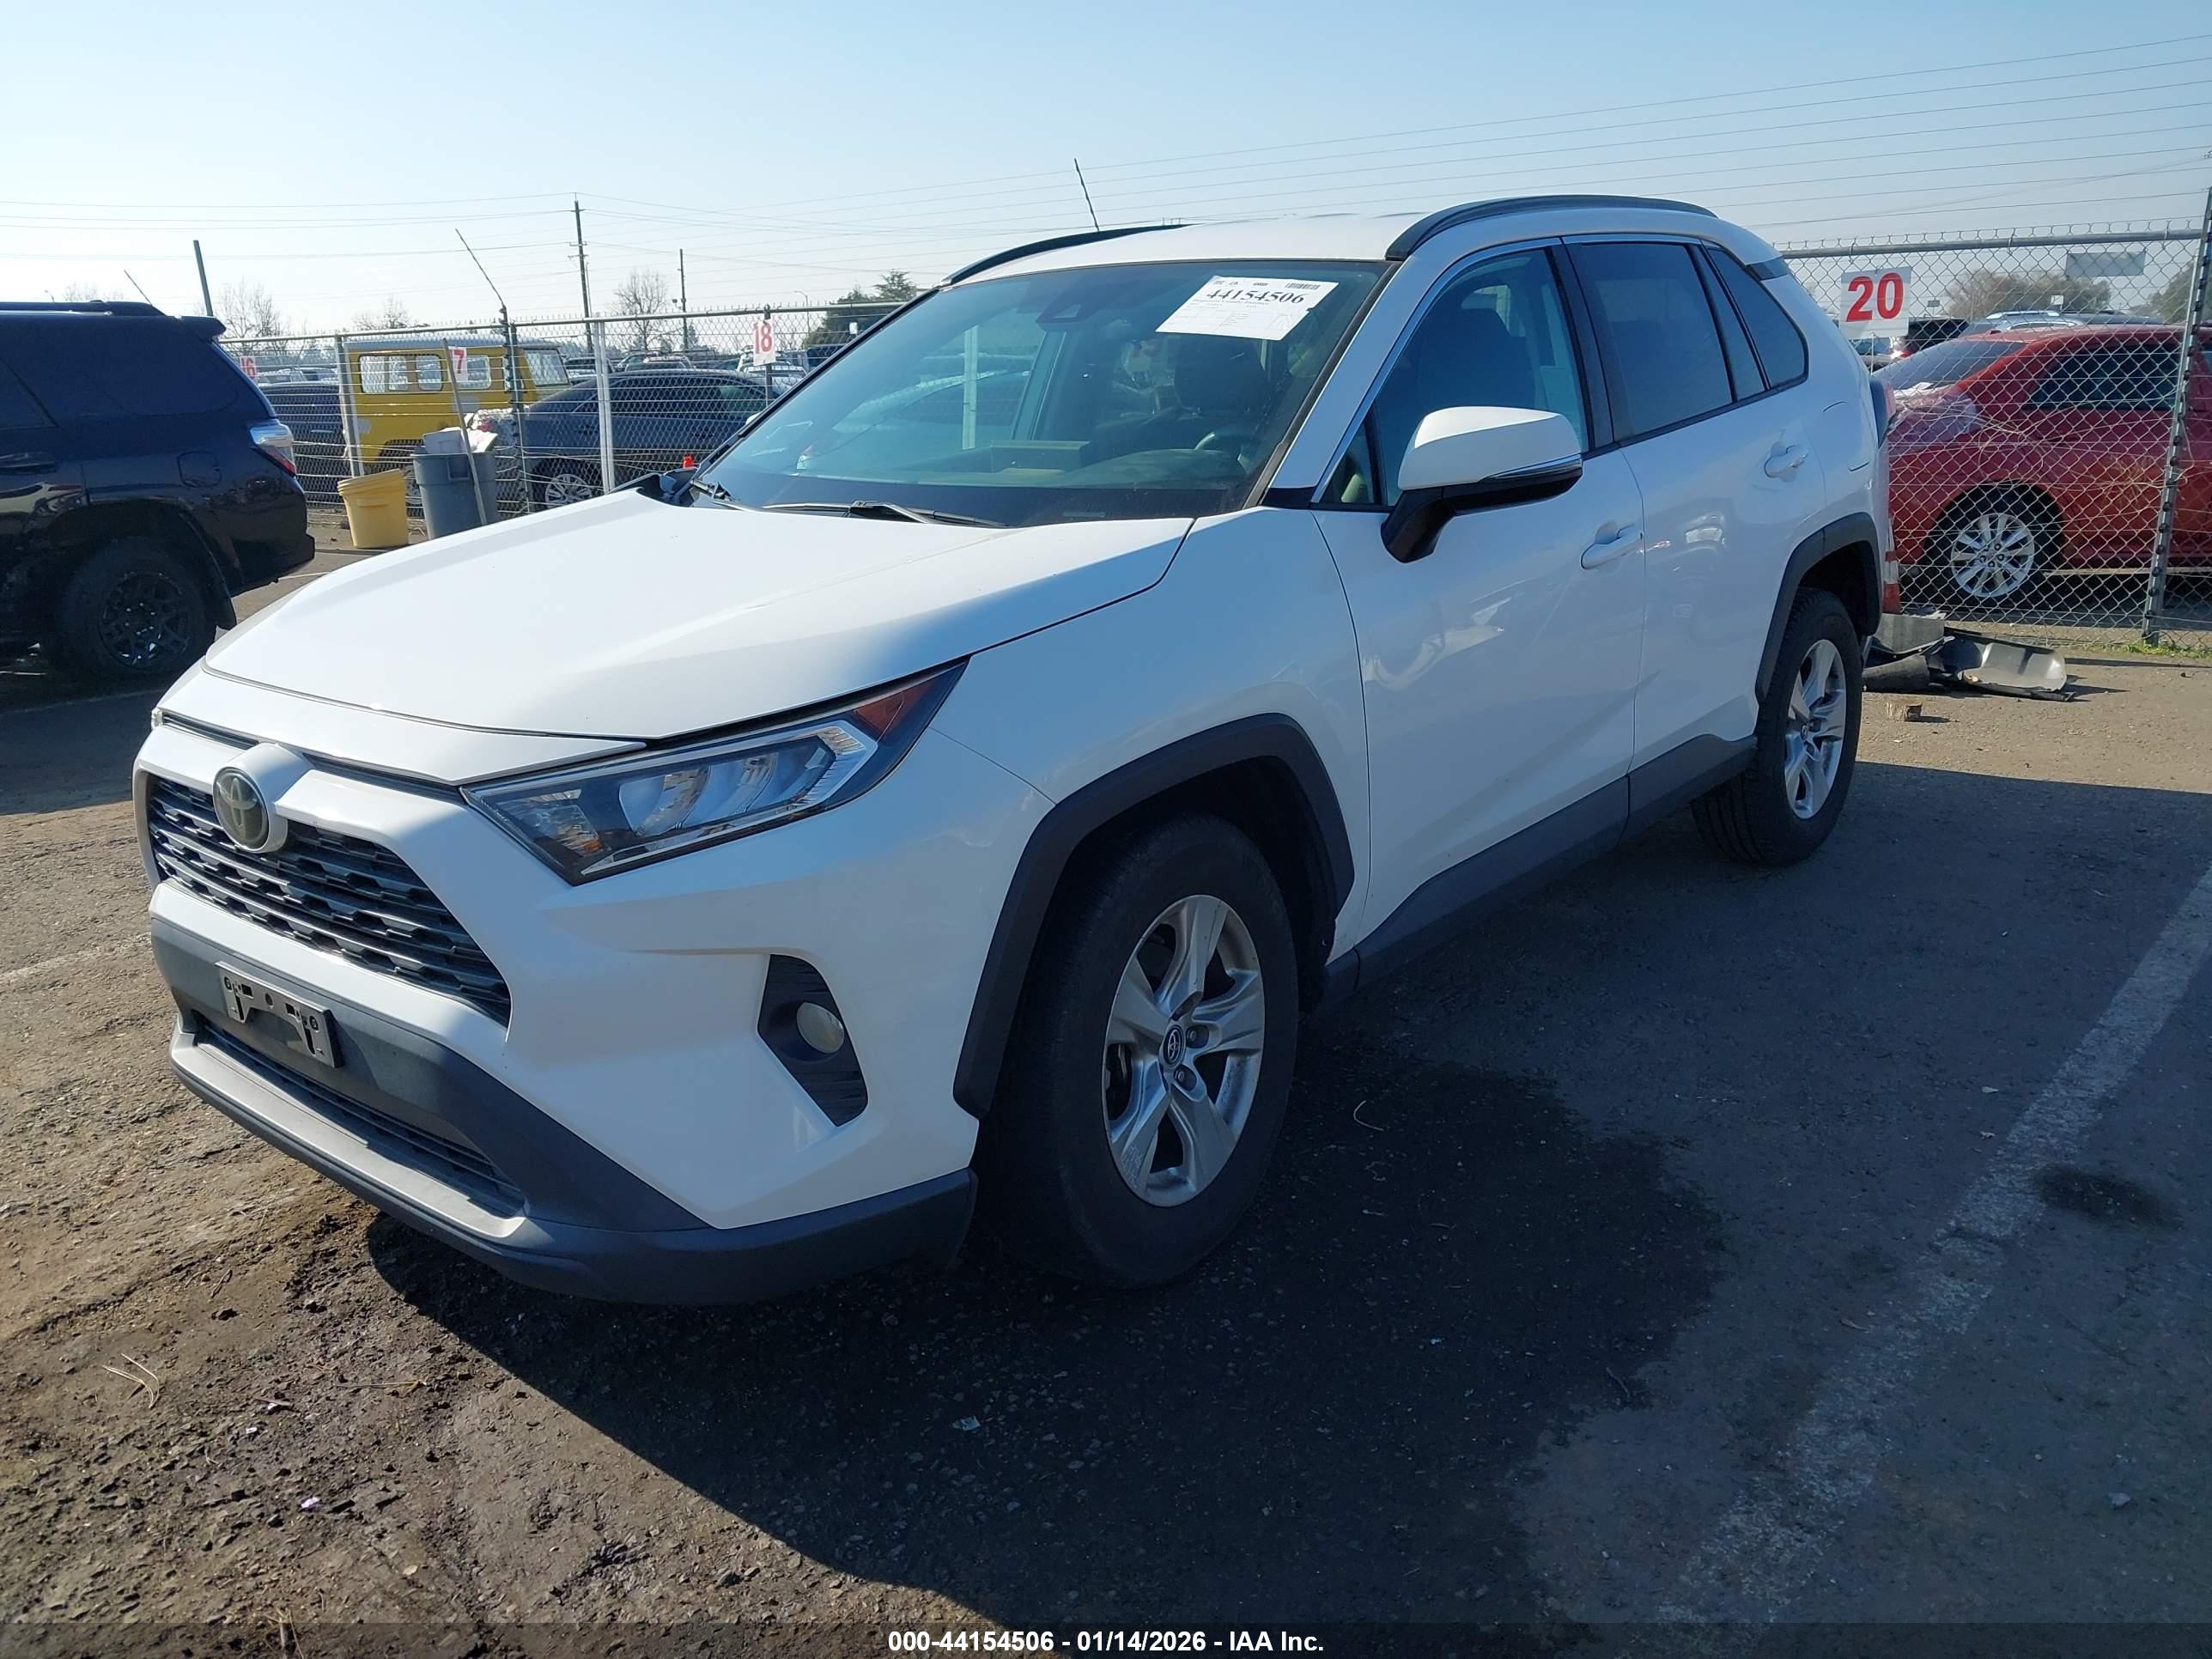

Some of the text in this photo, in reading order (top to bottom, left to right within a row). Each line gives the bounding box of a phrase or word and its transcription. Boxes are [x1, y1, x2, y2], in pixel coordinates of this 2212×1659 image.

[1206, 289, 1308, 304] 44154506
[1846, 272, 1904, 322] 20
[754, 322, 772, 354] 18
[451, 349, 465, 374] 7
